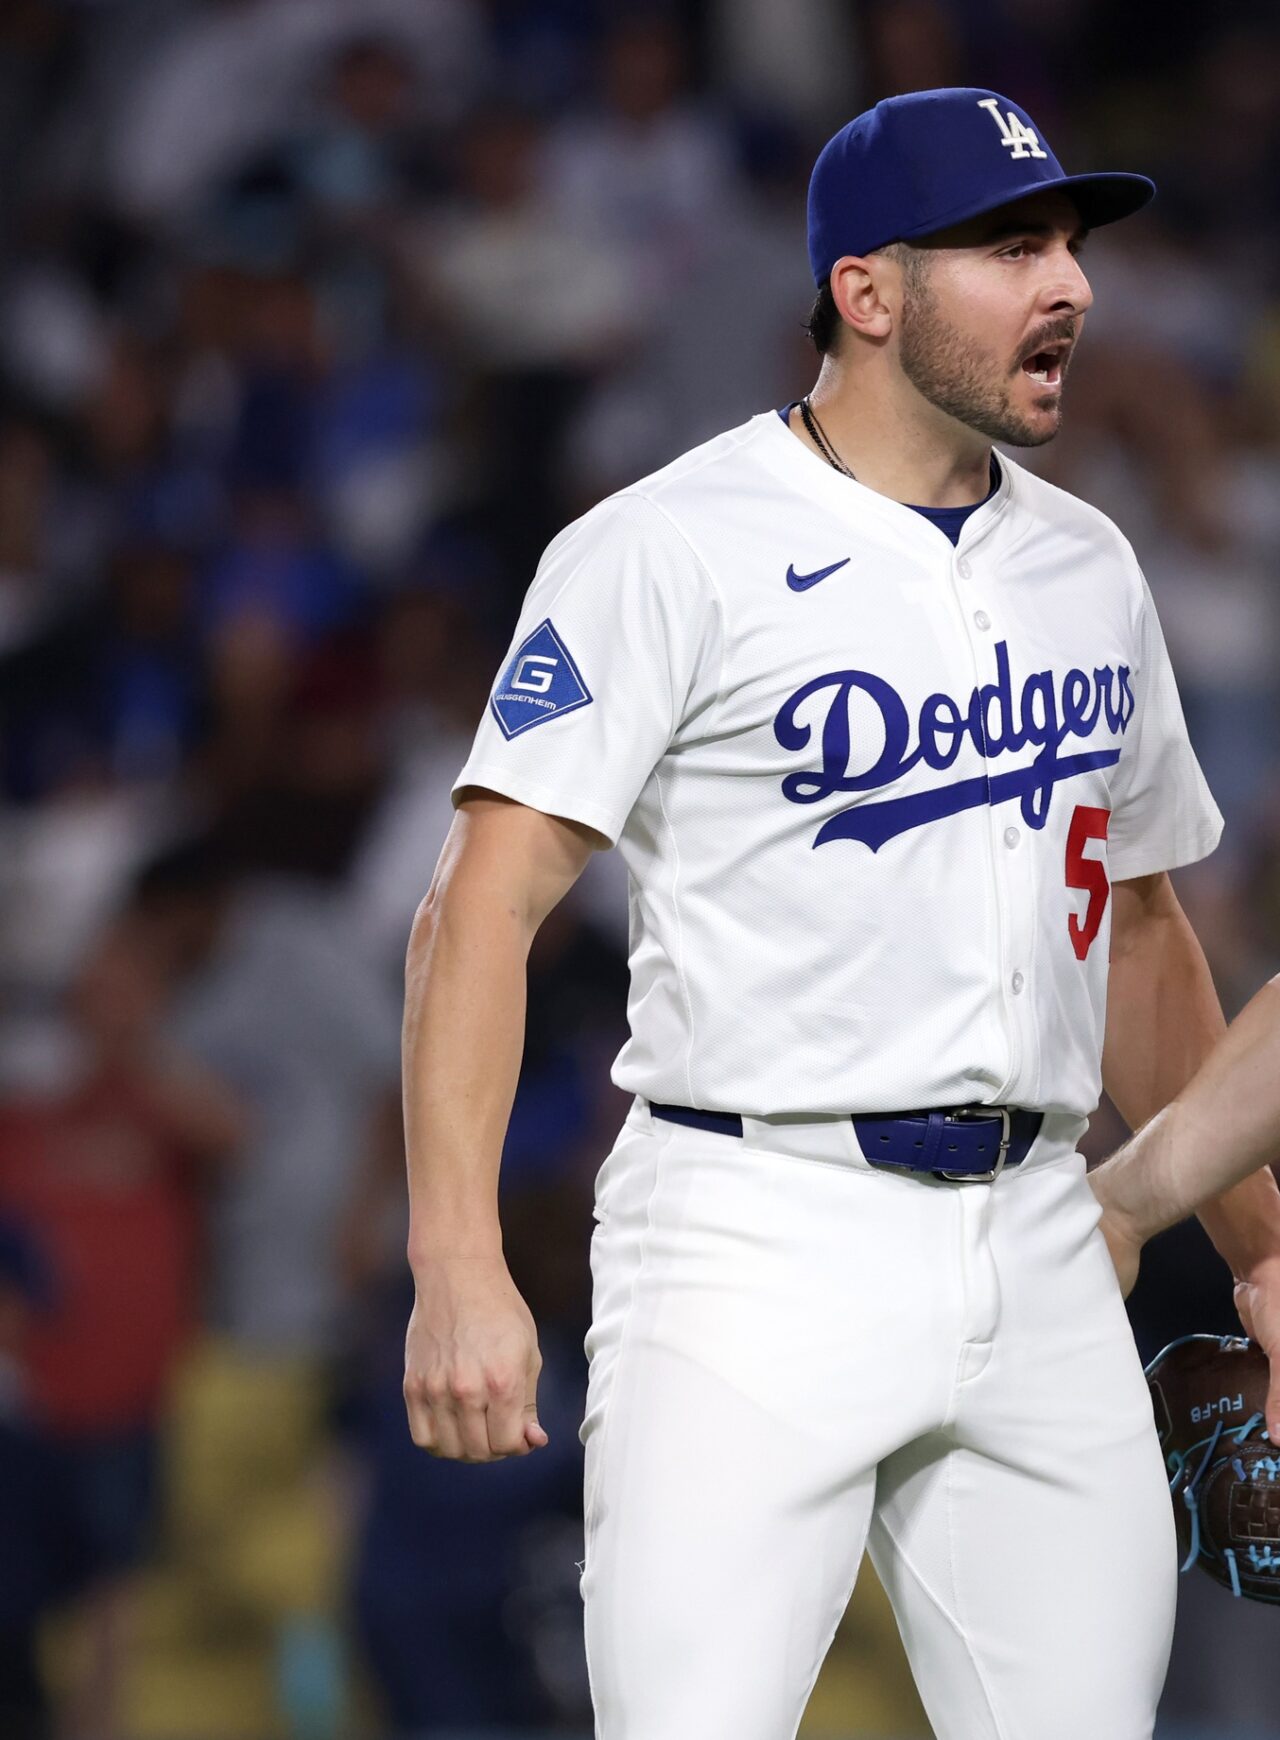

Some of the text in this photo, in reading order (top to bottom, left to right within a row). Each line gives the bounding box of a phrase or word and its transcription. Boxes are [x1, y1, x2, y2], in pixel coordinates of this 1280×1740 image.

[977, 98, 1047, 159] LA
[495, 694, 557, 711] GUGGENHEIM
[511, 655, 558, 693] G
[774, 640, 1135, 830] Dodgers
[1065, 805, 1111, 961] 5
